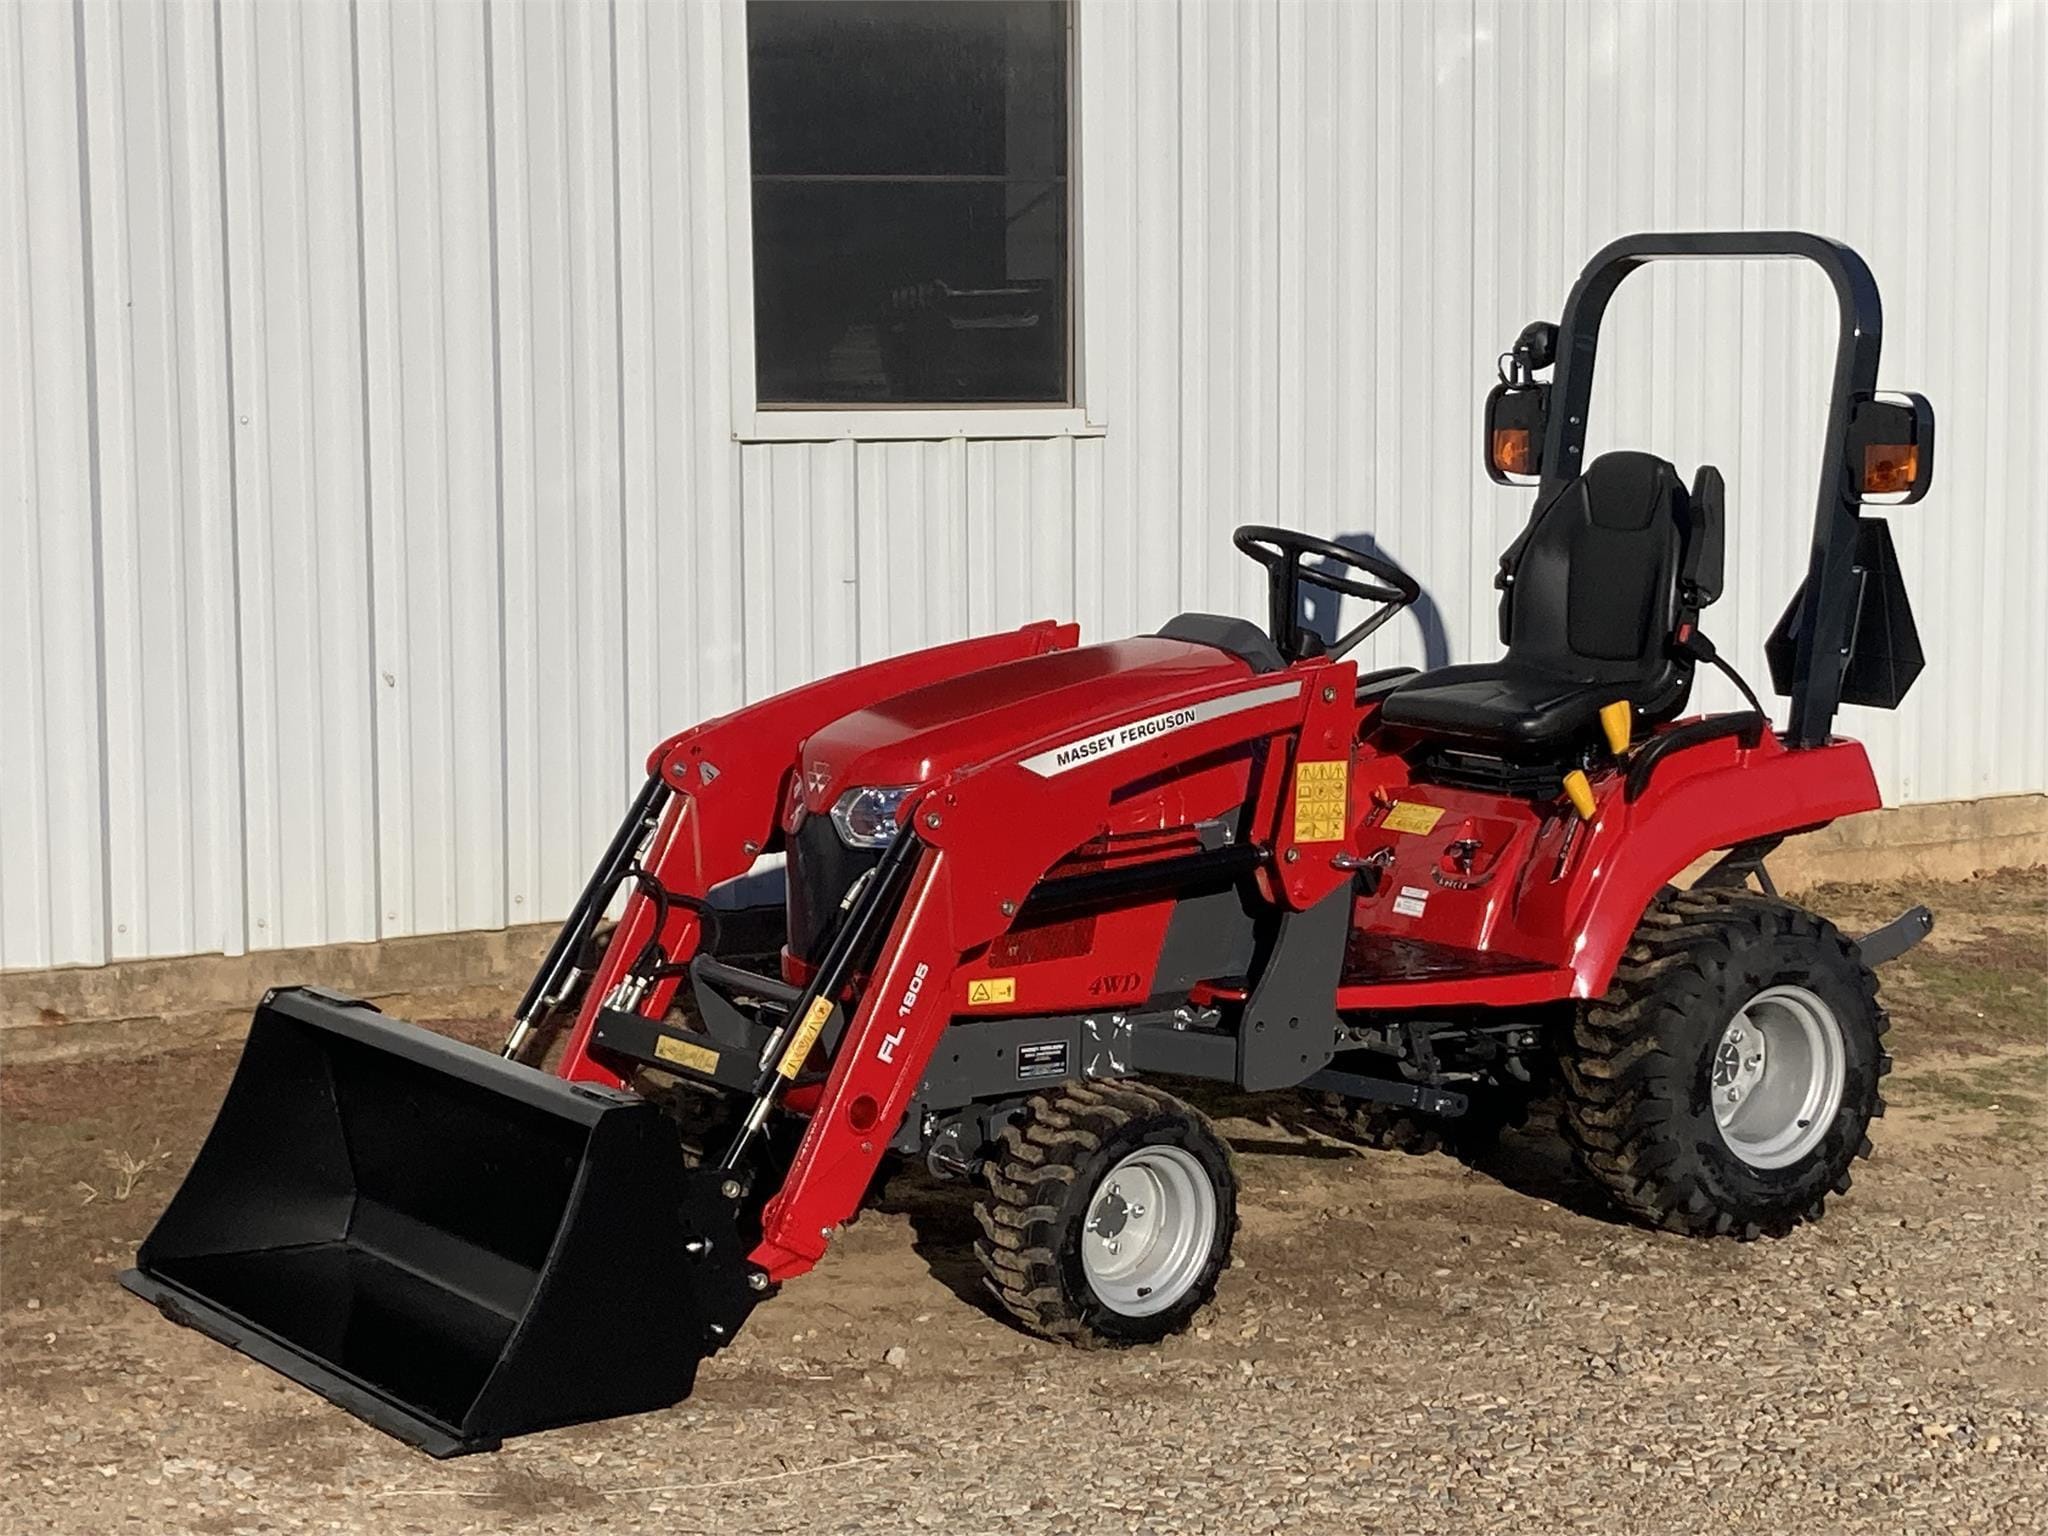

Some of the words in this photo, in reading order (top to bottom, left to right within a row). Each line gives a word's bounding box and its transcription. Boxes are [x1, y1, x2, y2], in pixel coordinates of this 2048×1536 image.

[1057, 735, 1115, 766] MASSEY
[1120, 710, 1195, 744] FERGUSON
[1088, 973, 1141, 995] 4WD
[877, 1027, 906, 1064] FL
[899, 962, 928, 1016] 1805
